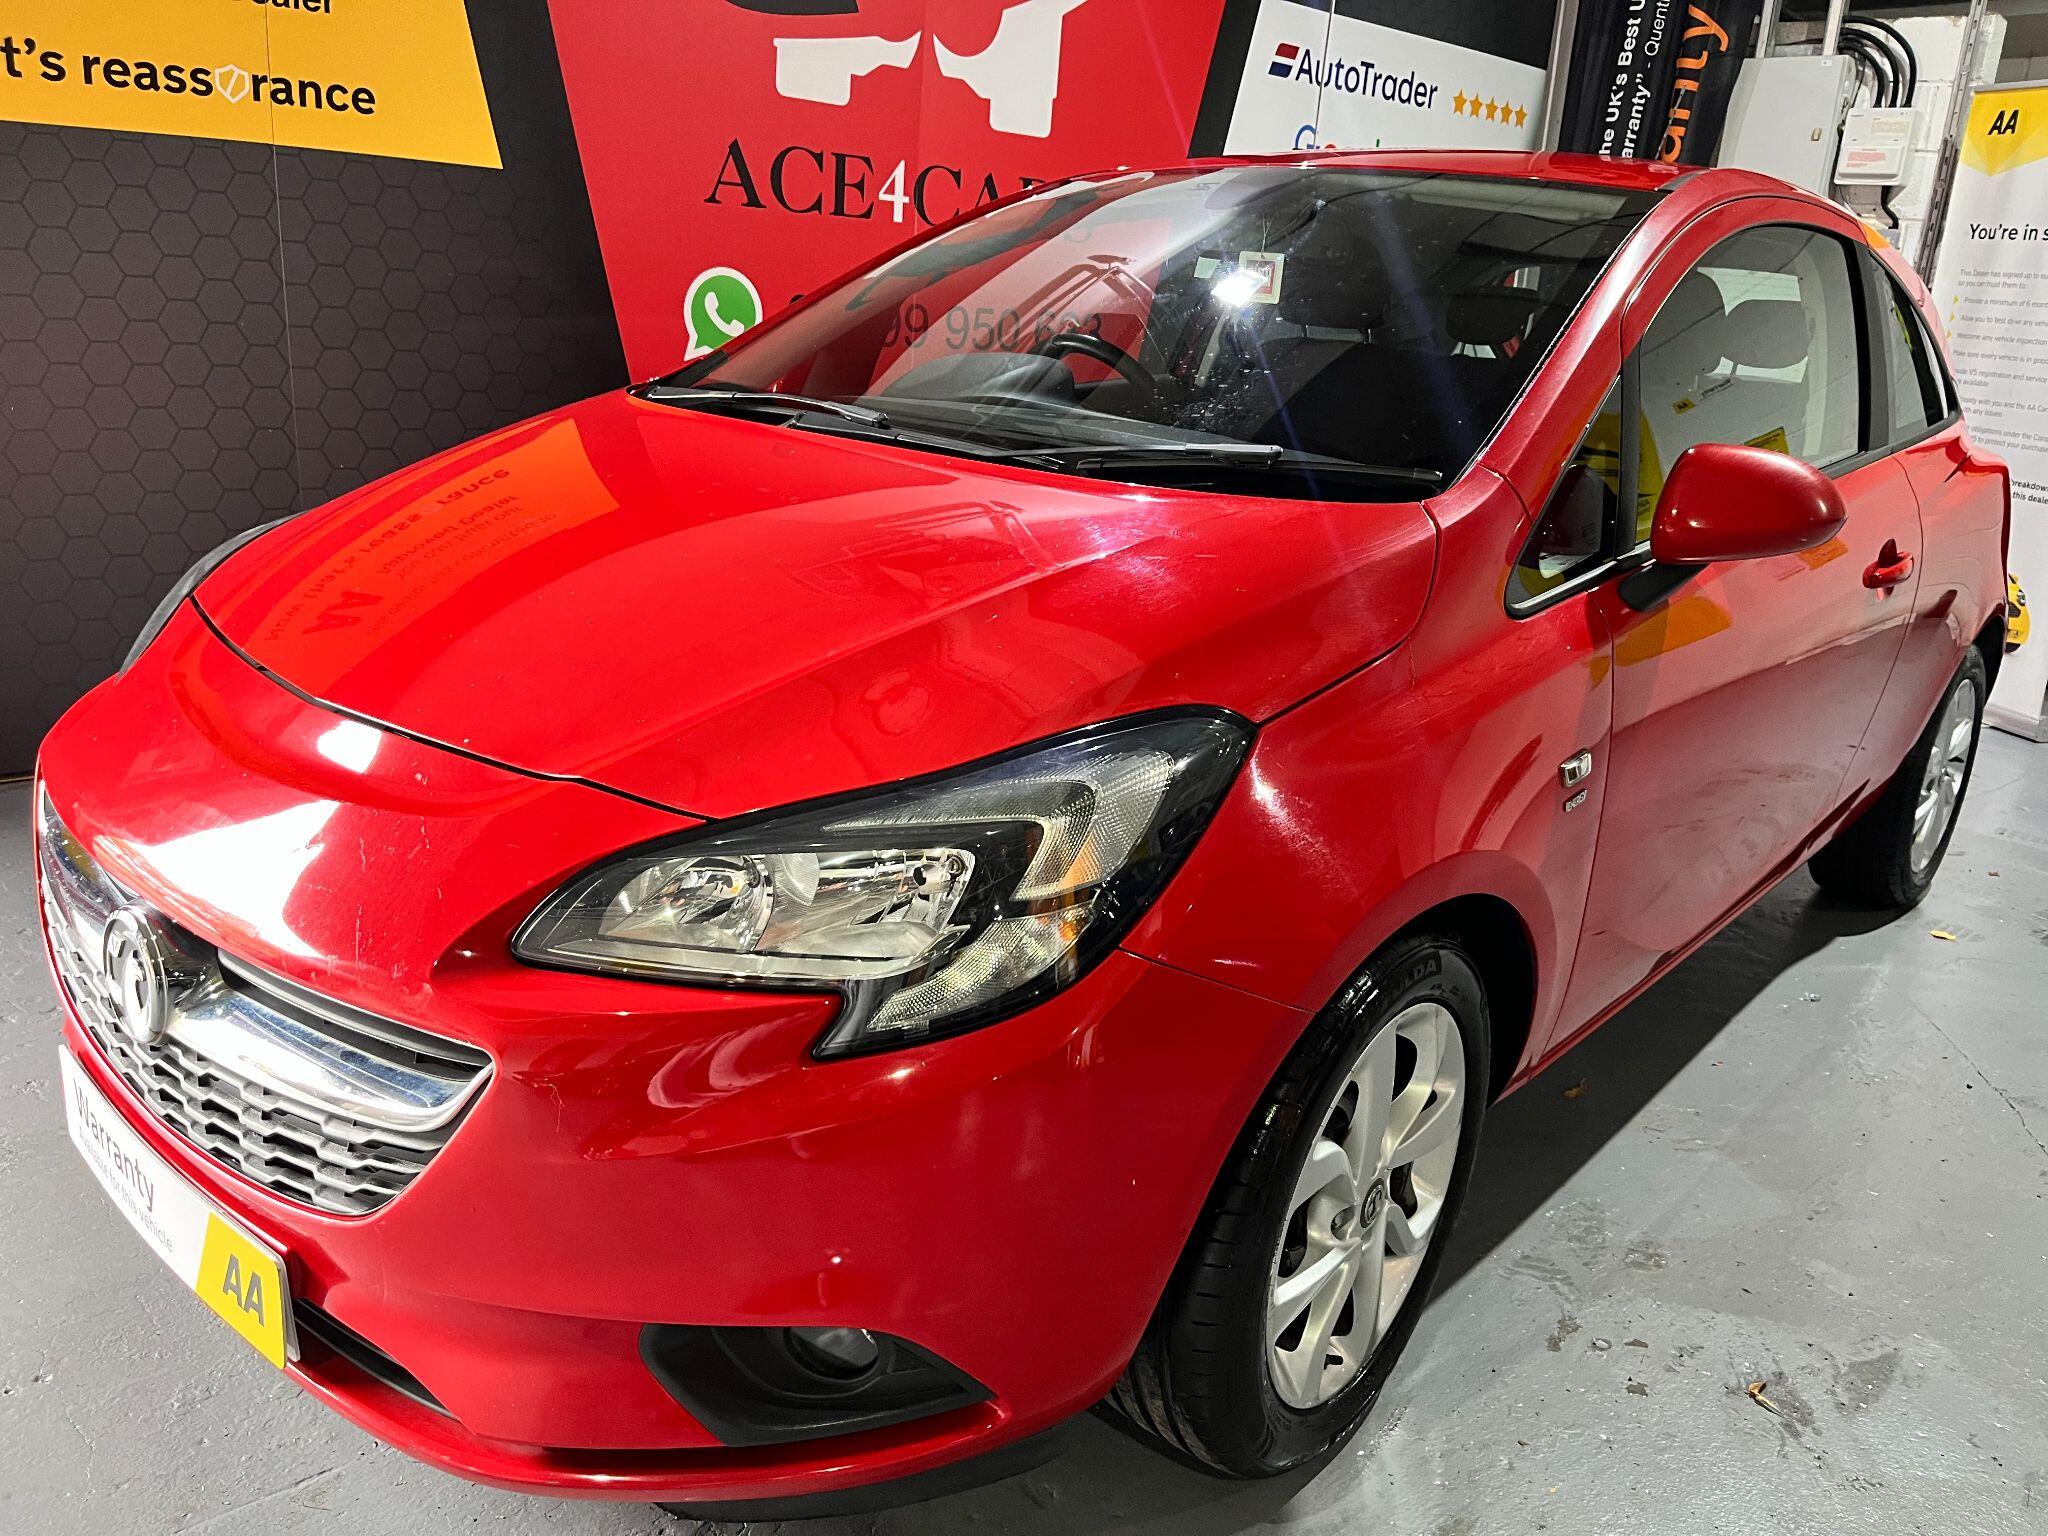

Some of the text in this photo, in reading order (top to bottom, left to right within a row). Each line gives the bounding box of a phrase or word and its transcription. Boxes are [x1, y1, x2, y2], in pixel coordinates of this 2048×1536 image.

[1295, 48, 1438, 109] AutoTrader
[1605, 73, 1628, 122] UK's
[1617, 17, 1642, 66] Best
[1988, 109, 2020, 135] AA
[1969, 223, 2019, 241] You're
[2023, 223, 2039, 241] in
[945, 306, 1020, 350] 950
[2012, 491, 2027, 501] this
[73, 1078, 155, 1213] Warranty
[121, 1184, 138, 1216] this
[139, 1208, 174, 1254] vehicle
[222, 1253, 265, 1327] AA
